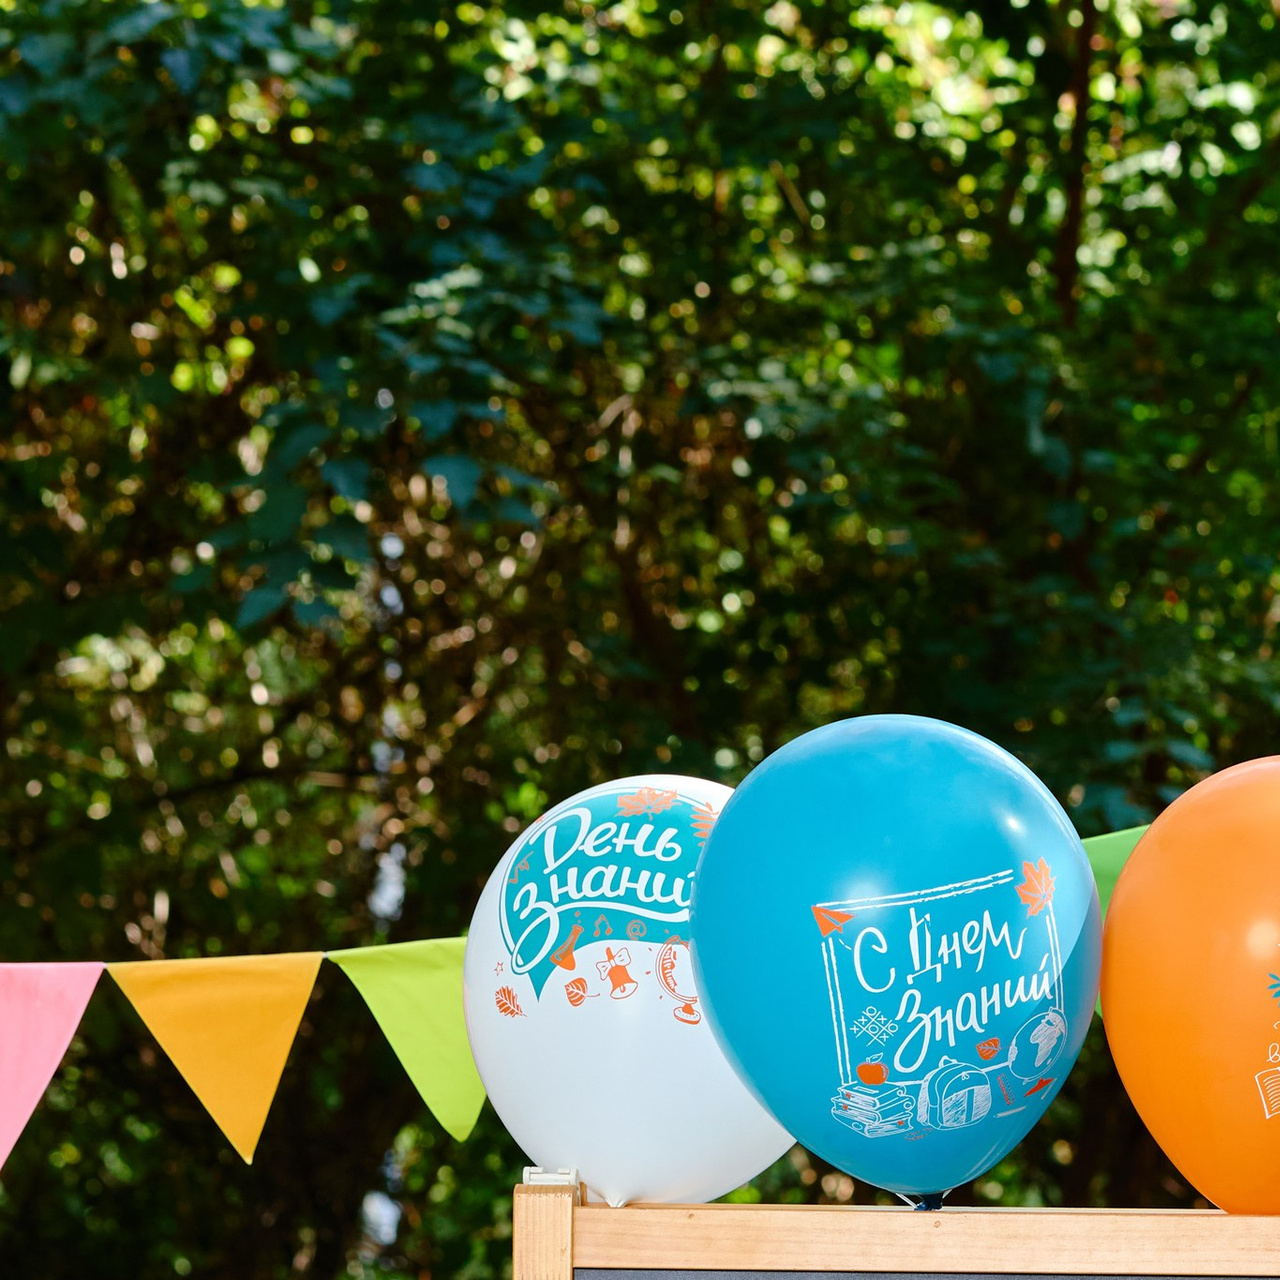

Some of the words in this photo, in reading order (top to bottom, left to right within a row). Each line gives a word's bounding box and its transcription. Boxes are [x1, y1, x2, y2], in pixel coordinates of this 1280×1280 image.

[529, 807, 682, 875] День
[511, 864, 697, 974] Знани
[853, 926, 896, 993] С
[906, 907, 1028, 985] Днем
[893, 952, 1054, 1074] Знаний
